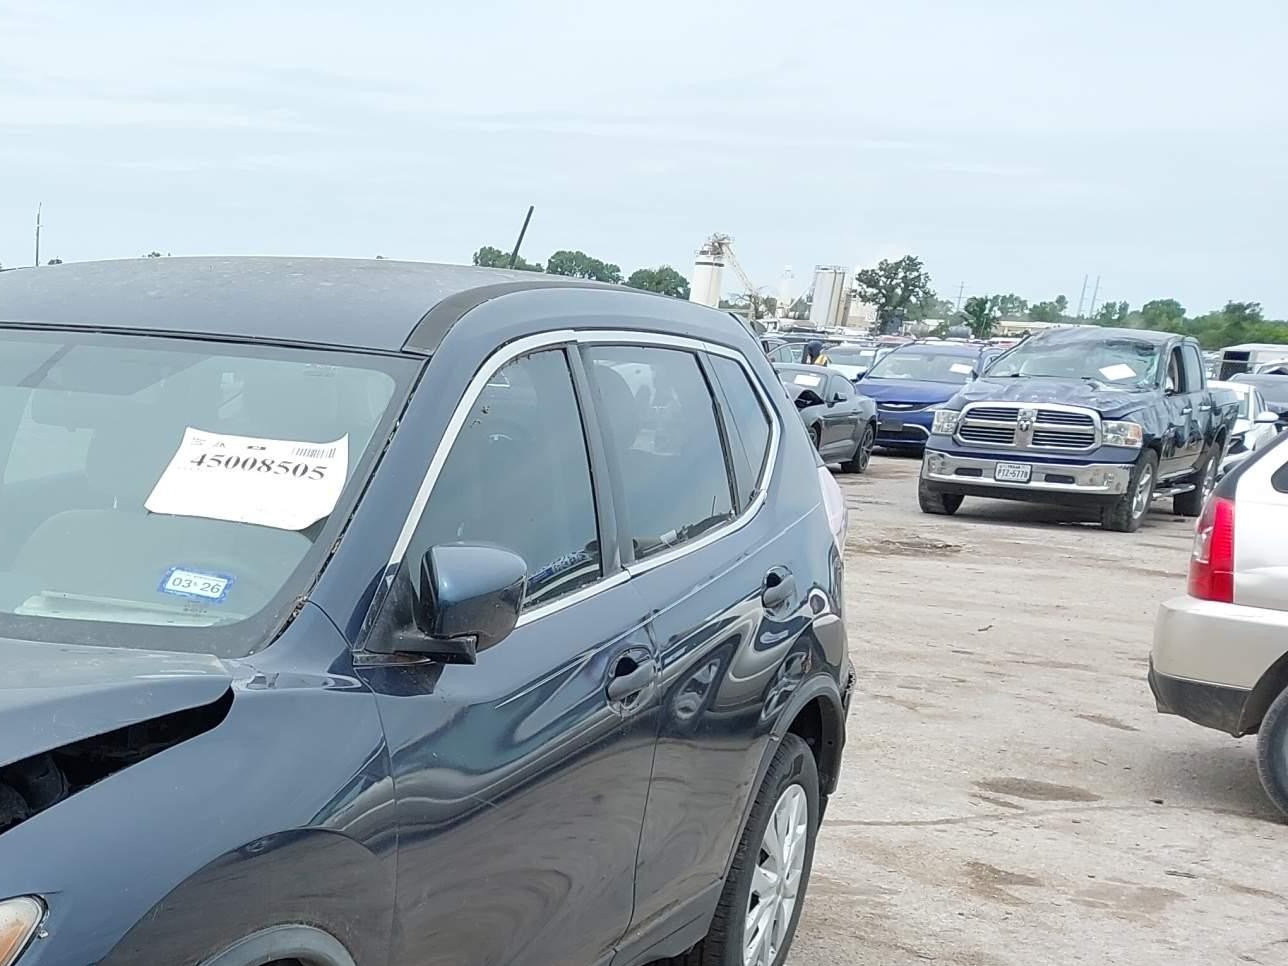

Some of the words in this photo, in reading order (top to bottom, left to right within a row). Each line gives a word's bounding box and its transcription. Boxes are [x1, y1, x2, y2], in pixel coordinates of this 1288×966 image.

[190, 453, 328, 480] 45008505
[172, 577, 192, 588] 03
[199, 582, 222, 593] 26
